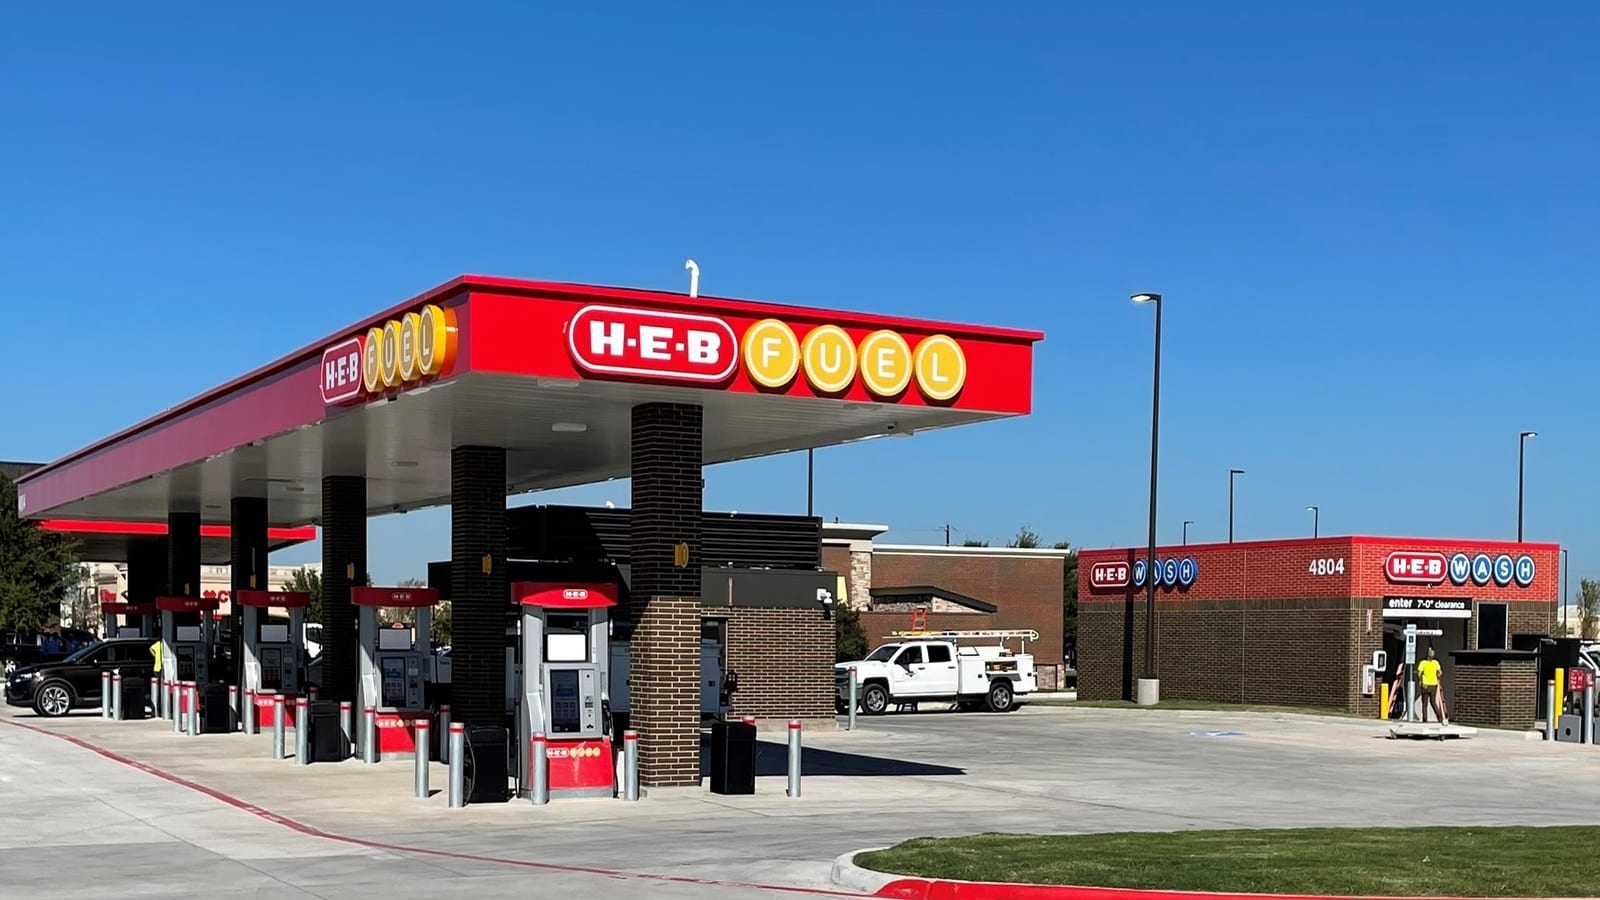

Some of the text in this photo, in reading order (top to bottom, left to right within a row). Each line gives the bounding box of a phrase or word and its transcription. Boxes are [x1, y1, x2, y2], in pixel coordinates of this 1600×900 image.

[367, 324, 430, 375] FUEL
[762, 338, 949, 383] FUEL
[1309, 558, 1345, 576] 4804
[1454, 562, 1531, 577] WASH
[1388, 598, 1413, 608] enter
[1434, 600, 1465, 609] clearance
